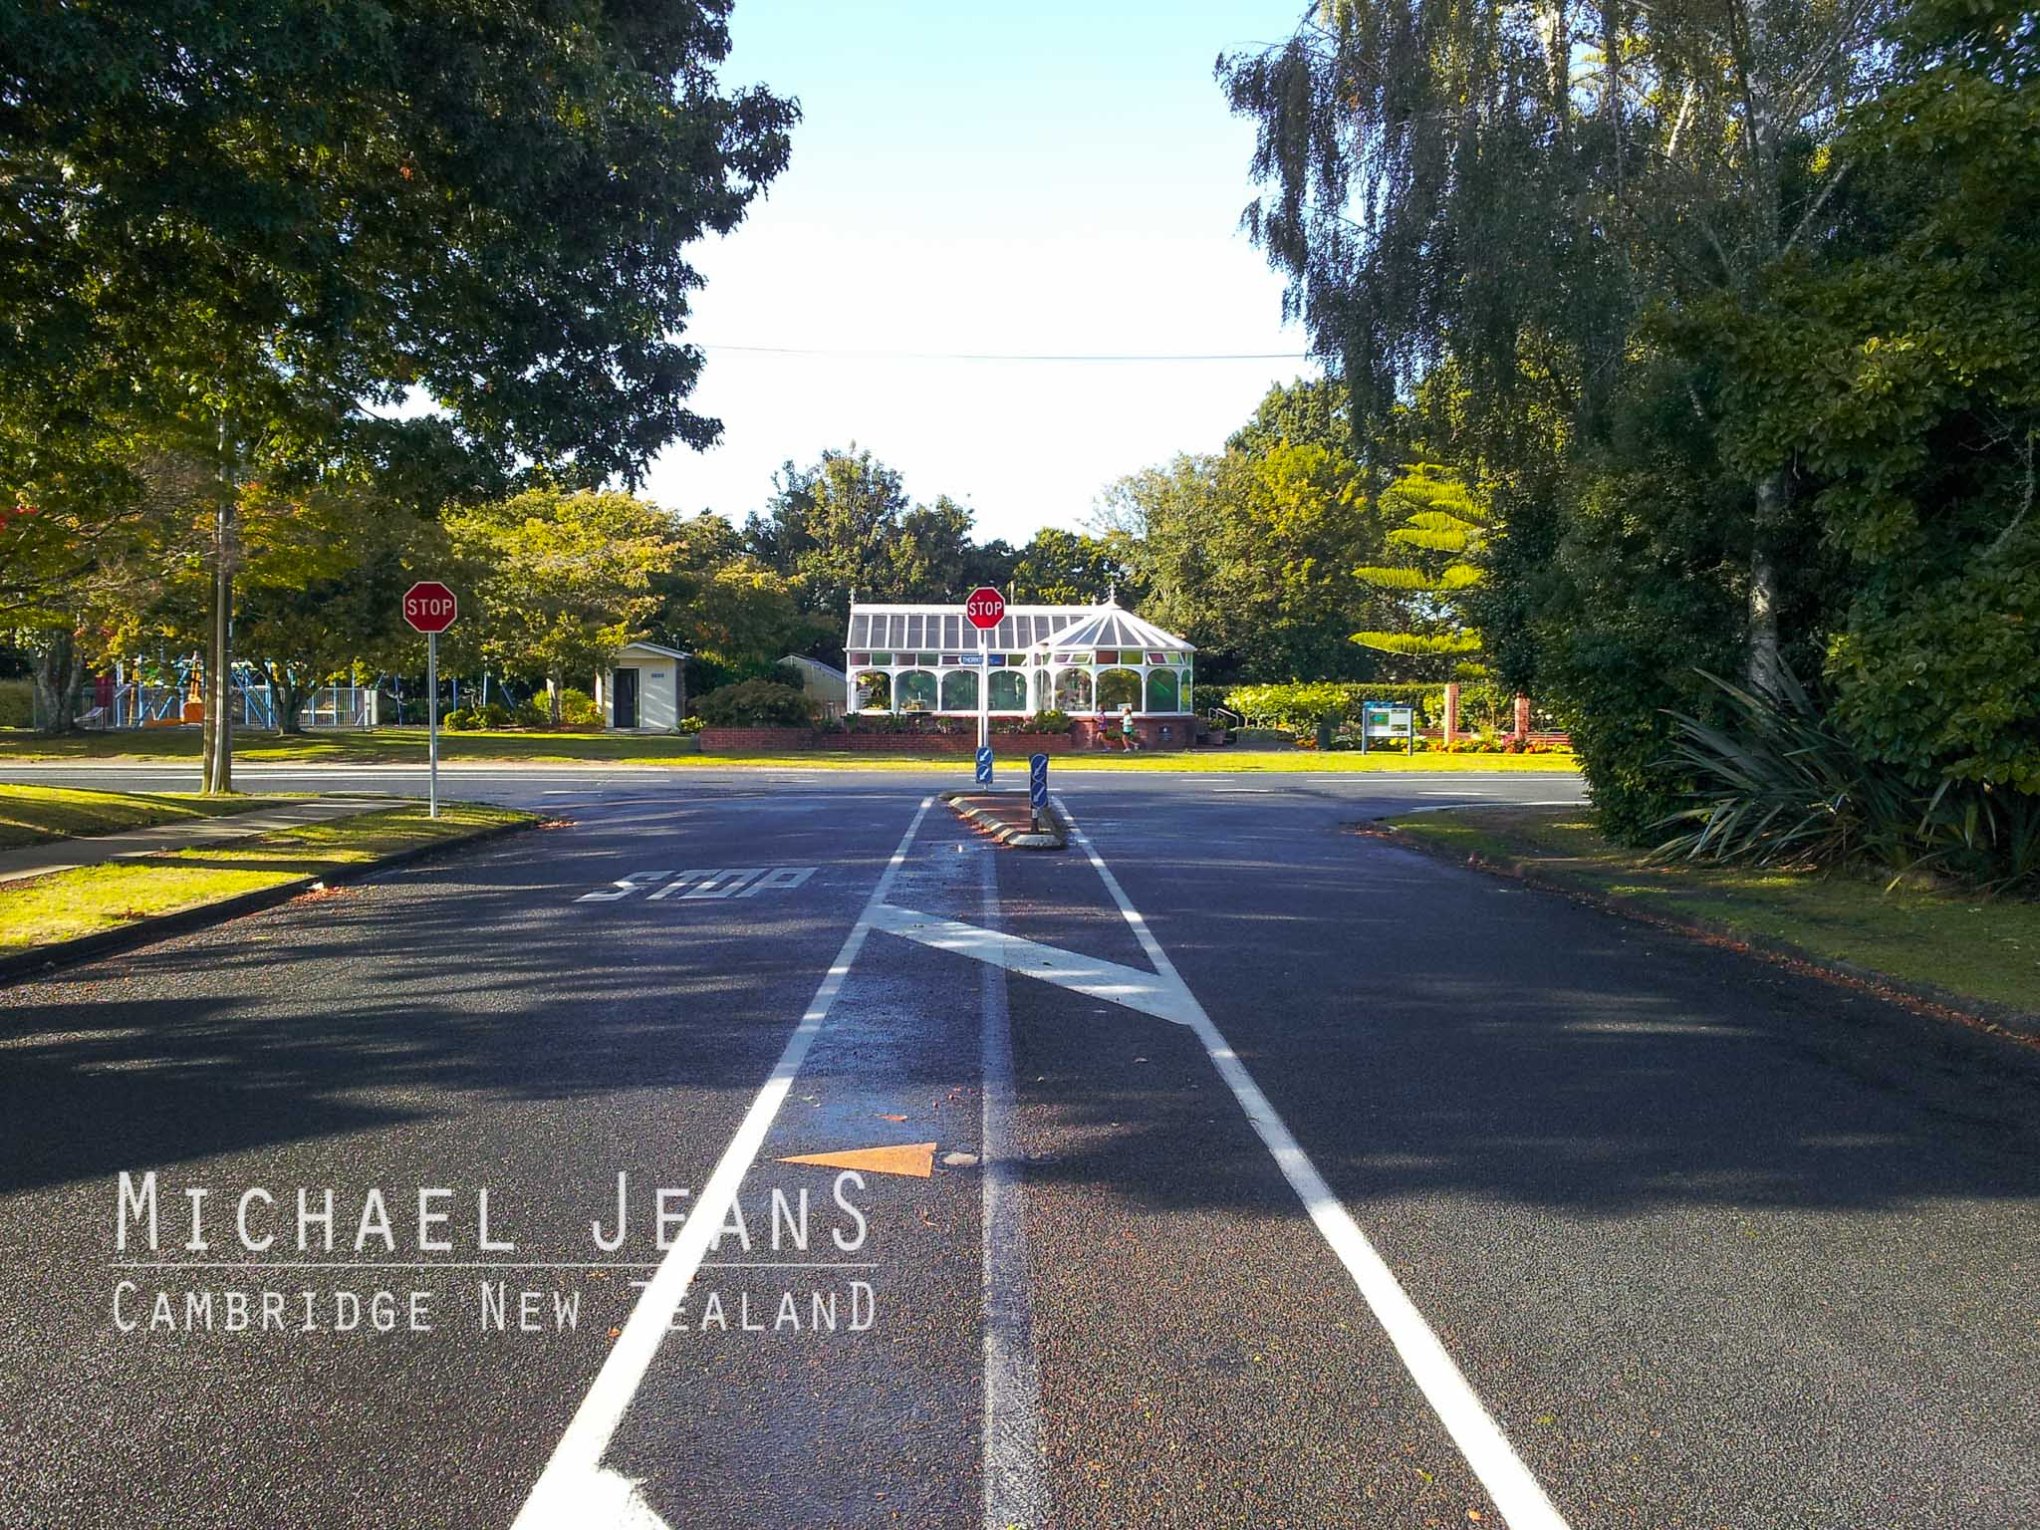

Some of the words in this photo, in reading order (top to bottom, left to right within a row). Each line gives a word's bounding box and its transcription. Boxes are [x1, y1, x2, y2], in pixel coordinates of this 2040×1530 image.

[407, 599, 453, 616] STOP
[969, 601, 1003, 617] STOP
[572, 866, 820, 903] STOP
